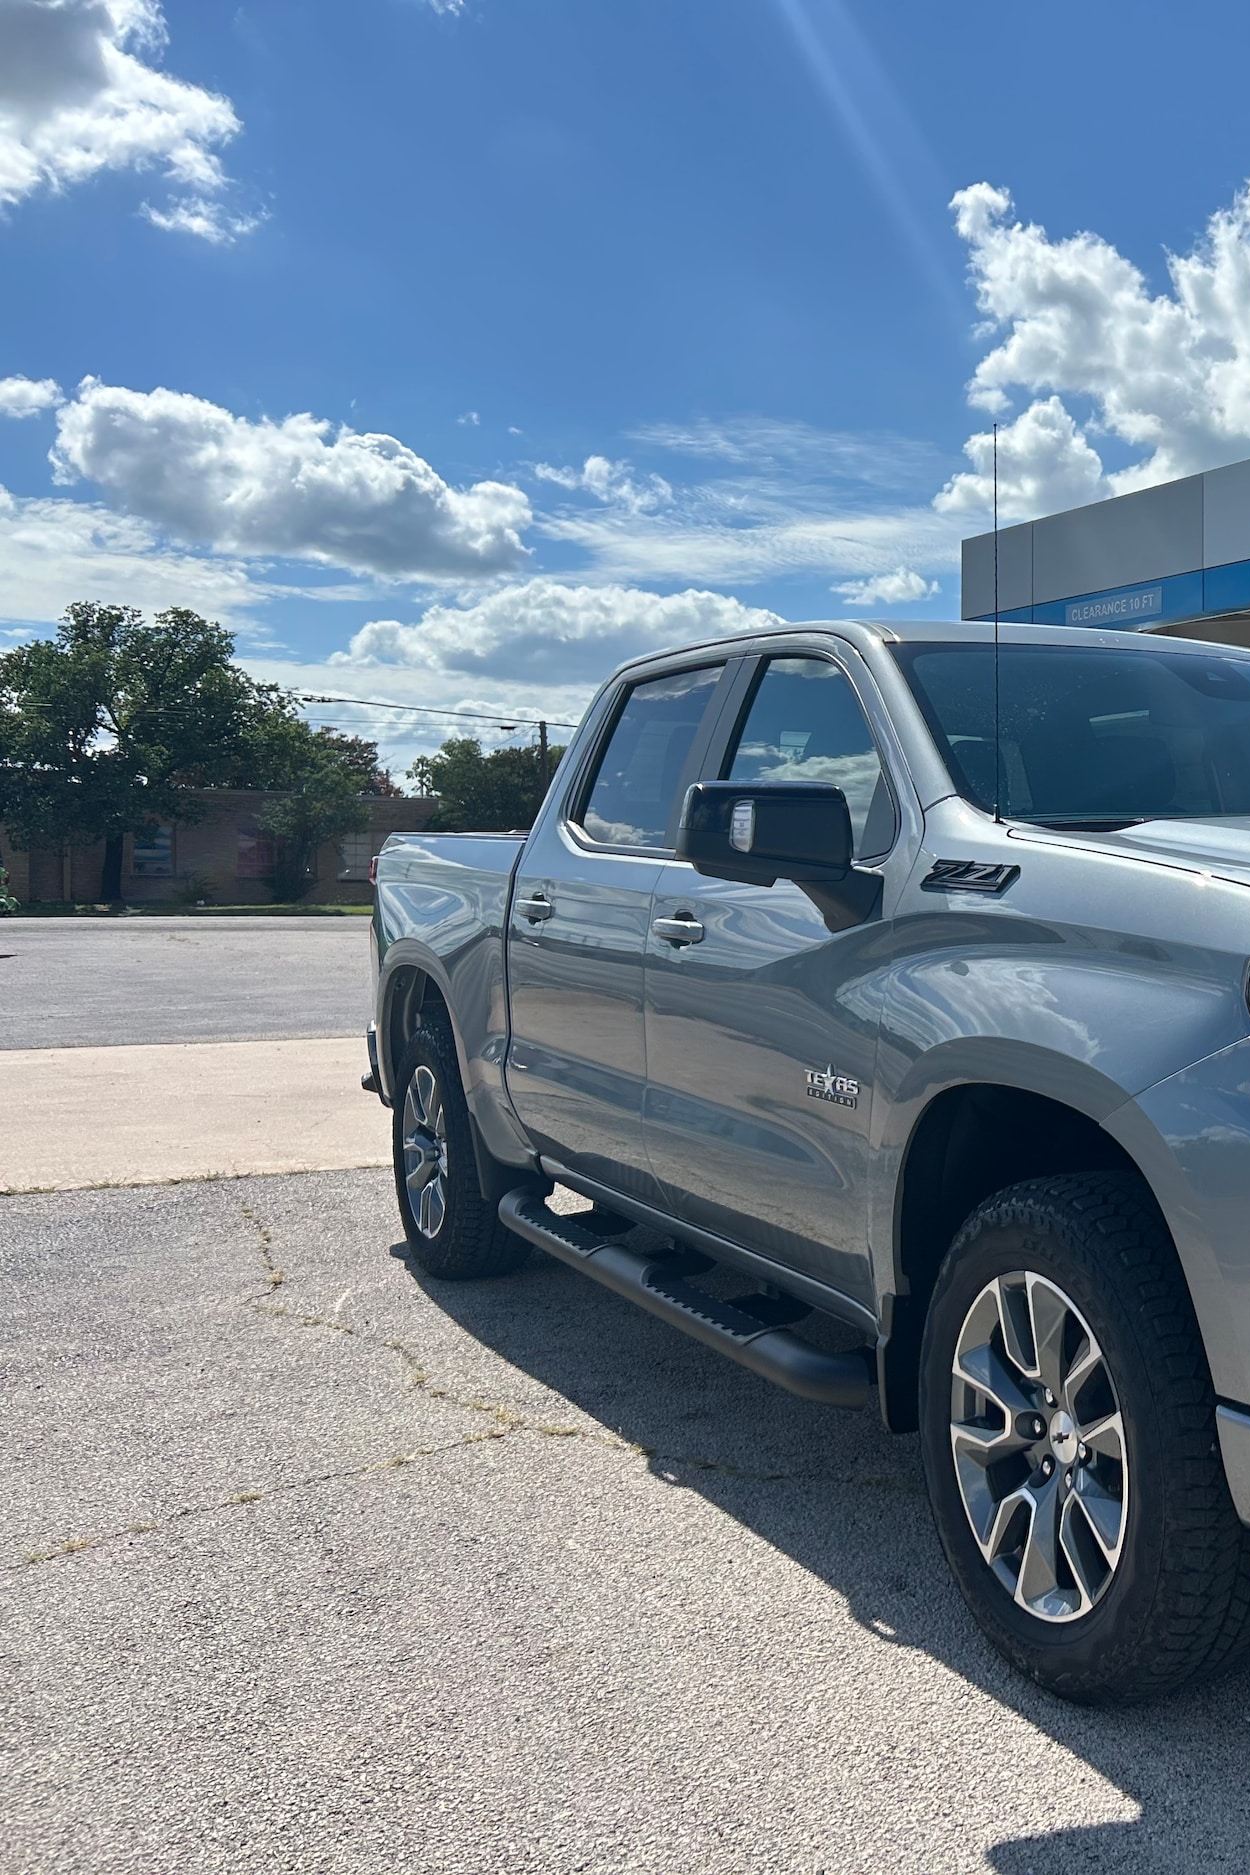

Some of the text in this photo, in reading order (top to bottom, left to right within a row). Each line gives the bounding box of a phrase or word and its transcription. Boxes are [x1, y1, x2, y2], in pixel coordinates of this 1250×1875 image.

[1071, 594, 1155, 622] CLEARANCE 10 FT
[808, 1089, 852, 1105] EDITION
